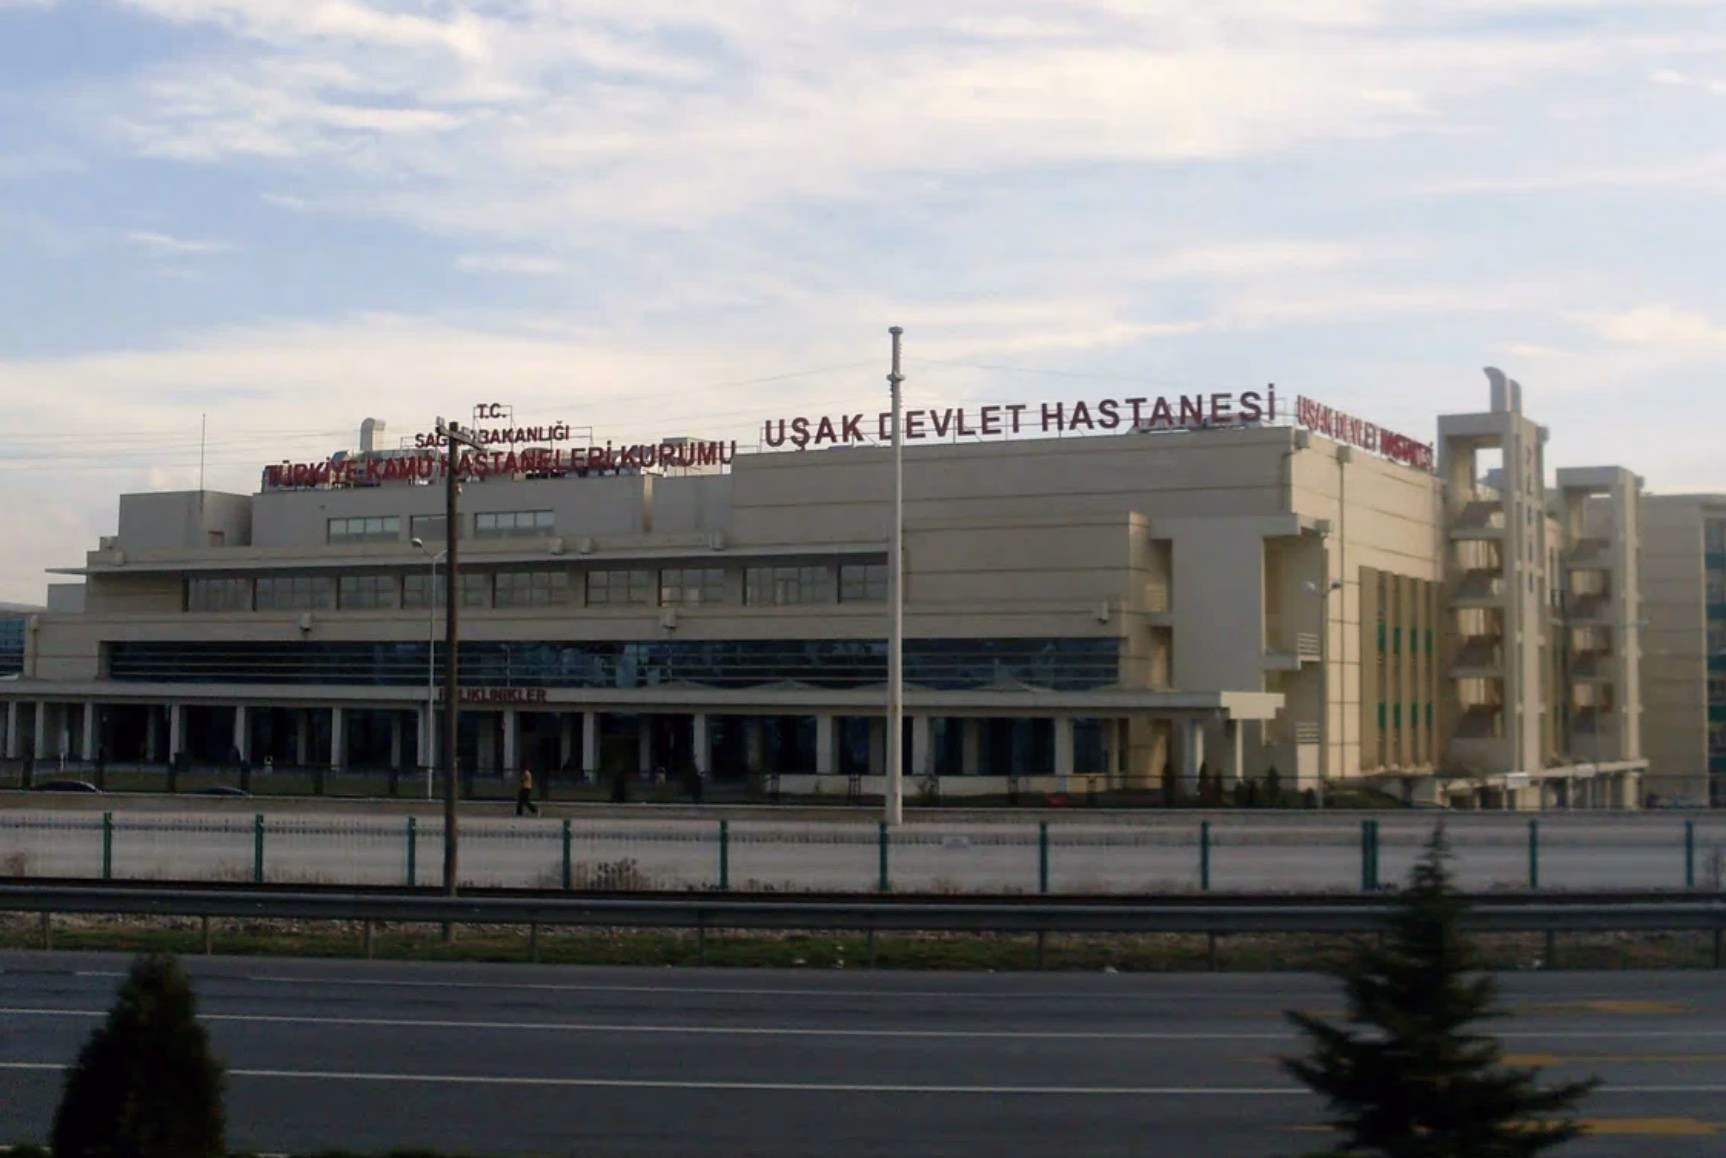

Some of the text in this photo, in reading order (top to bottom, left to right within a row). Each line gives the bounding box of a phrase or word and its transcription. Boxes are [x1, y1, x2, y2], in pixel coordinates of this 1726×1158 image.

[476, 403, 507, 419] T.C.
[479, 420, 570, 444] BAKANLIĞI
[765, 382, 1276, 451] UŞAK DEVLET HASTANESİ
[1296, 394, 1333, 437] UŞAK
[267, 457, 358, 487] TÜRKİYE
[367, 454, 434, 482] KAMU
[620, 440, 737, 469] KURUMU
